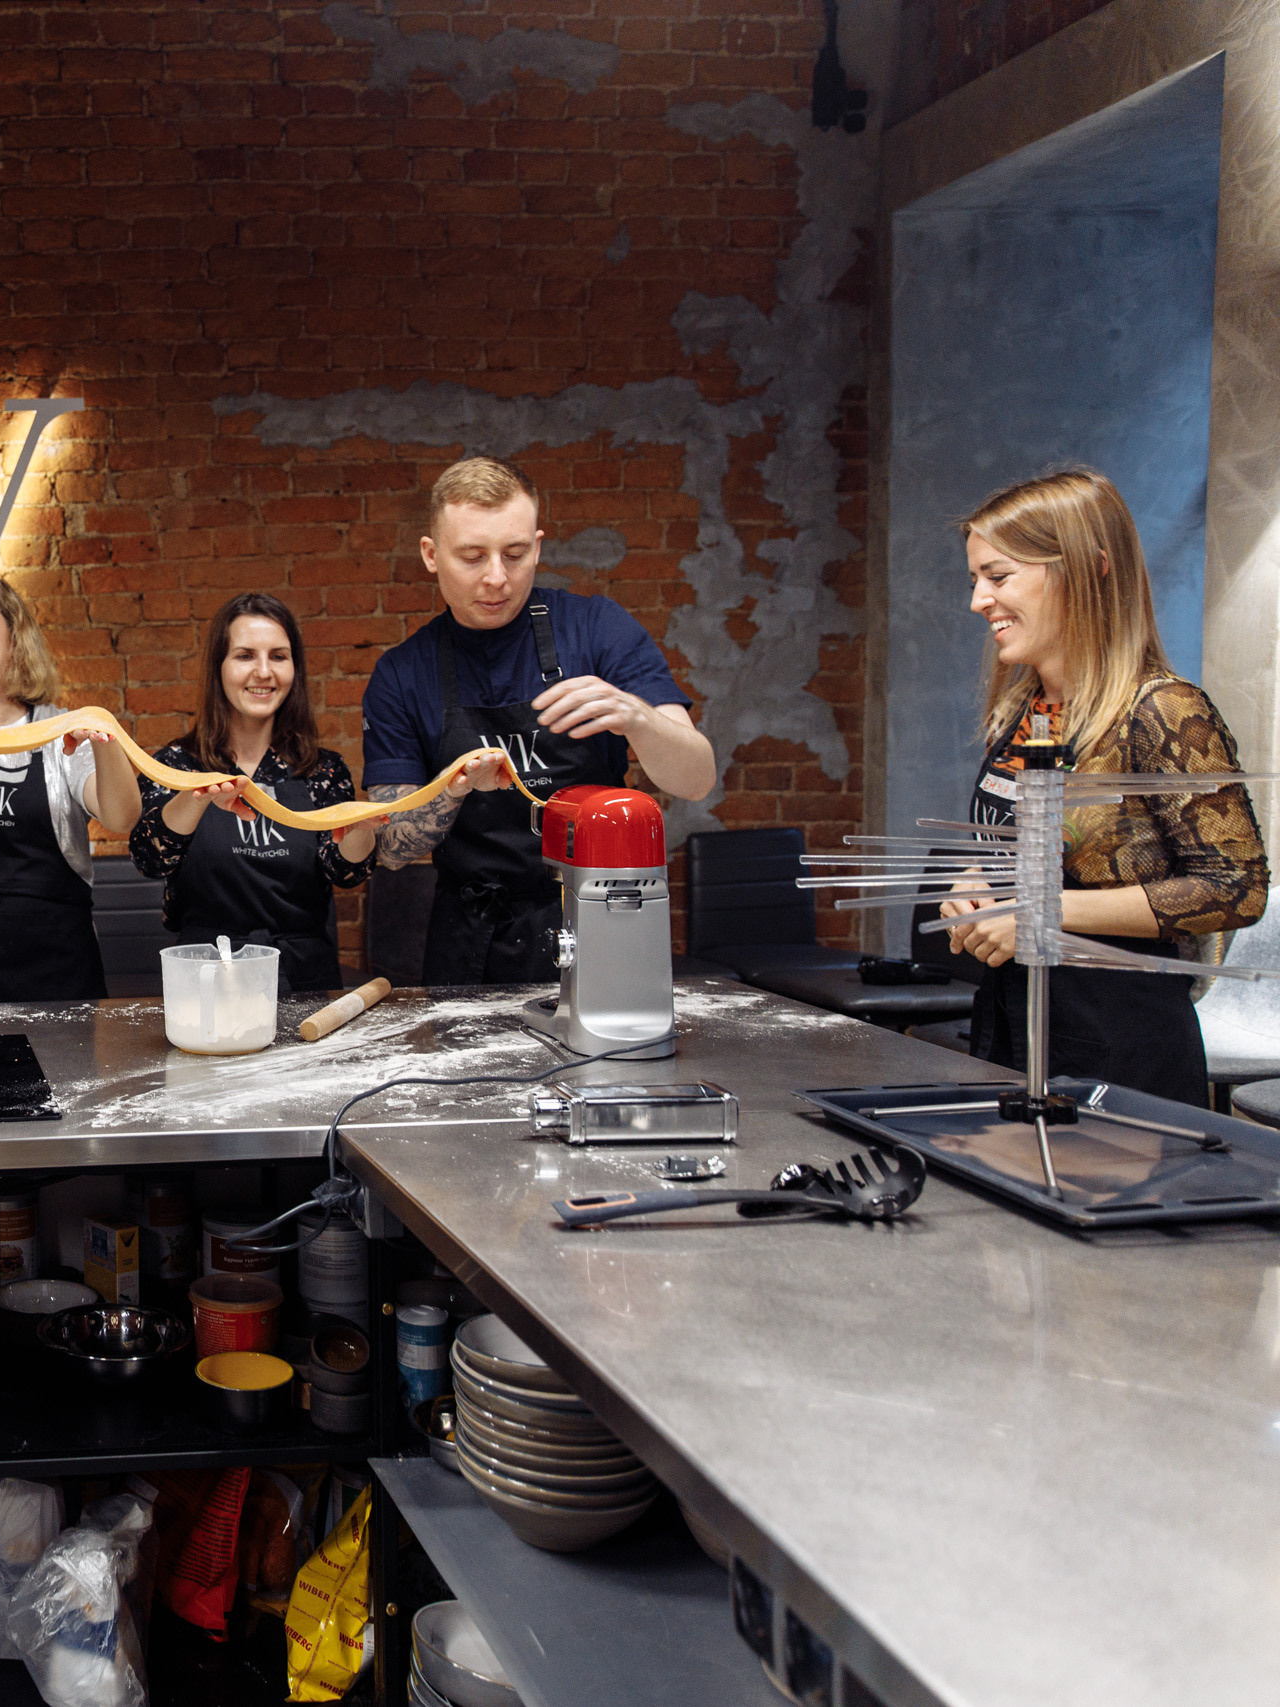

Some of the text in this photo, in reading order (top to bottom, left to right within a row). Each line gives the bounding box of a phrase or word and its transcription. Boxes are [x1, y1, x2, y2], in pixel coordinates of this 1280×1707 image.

[232, 847, 290, 858] WHITE KITCHEN
[298, 1580, 332, 1602] WIBER
[284, 1624, 313, 1651] WIBERG
[339, 1632, 364, 1650] WIBER
